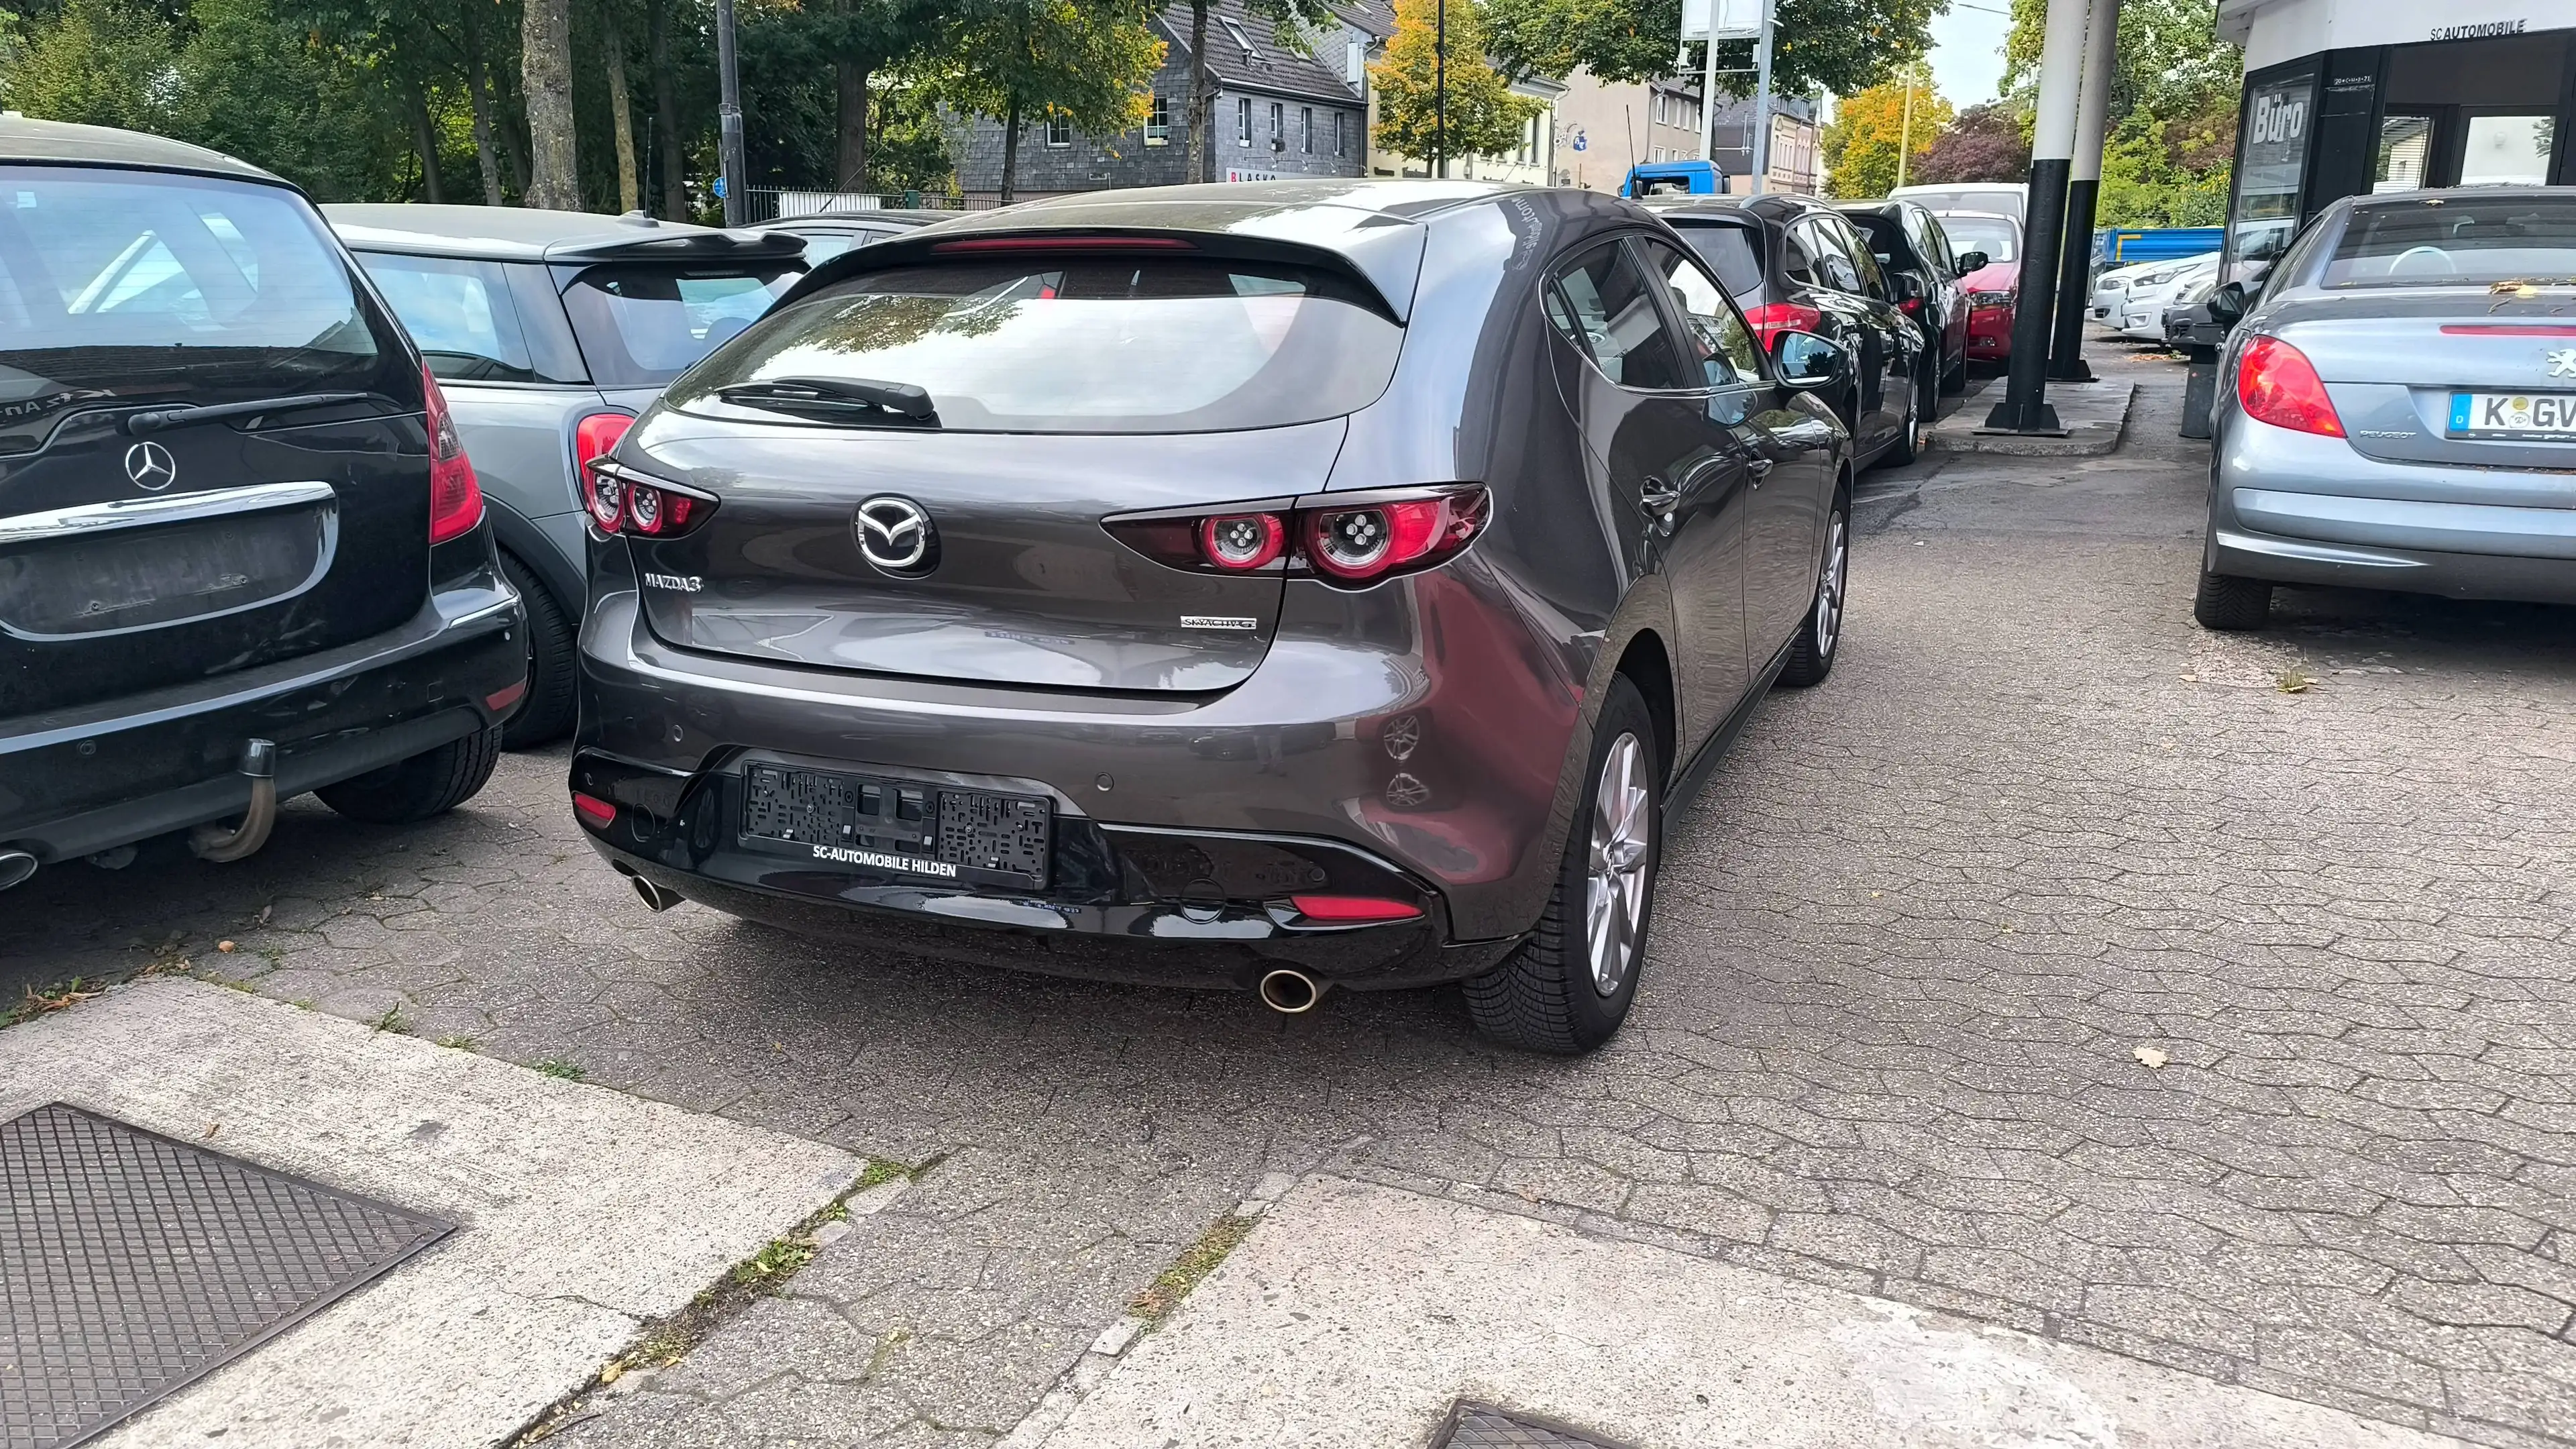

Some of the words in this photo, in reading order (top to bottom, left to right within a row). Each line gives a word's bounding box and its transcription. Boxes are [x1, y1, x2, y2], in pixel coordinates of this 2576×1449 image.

[2253, 93, 2303, 144] Büro
[2455, 415, 2464, 424] D
[2484, 397, 2509, 426] K
[2360, 430, 2416, 439] PEUGEOT
[645, 573, 702, 592] MAZDA3
[812, 845, 909, 871] SC-AUTOMOBILE
[912, 859, 957, 877] HILDEN
